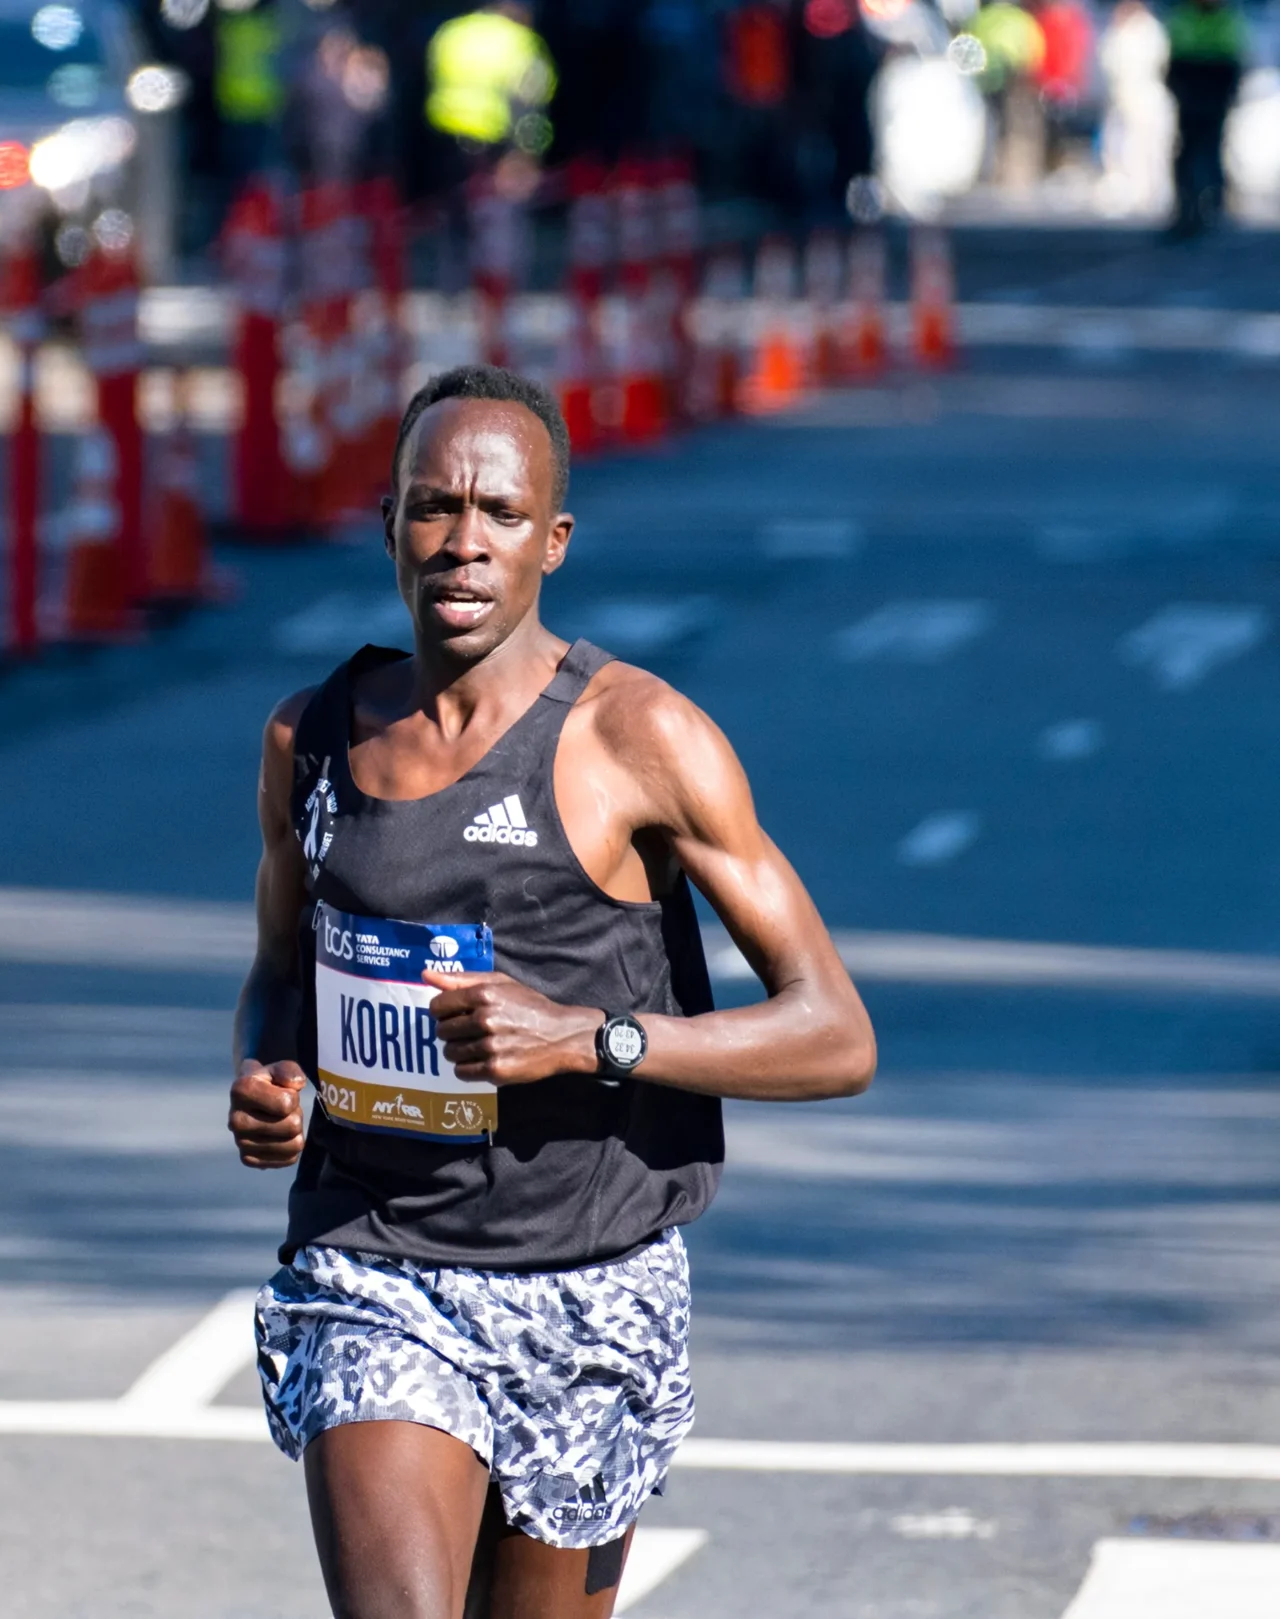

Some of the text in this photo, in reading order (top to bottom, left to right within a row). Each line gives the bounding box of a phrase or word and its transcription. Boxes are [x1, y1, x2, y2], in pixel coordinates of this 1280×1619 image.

[463, 824, 538, 847] adidas
[324, 915, 354, 960] tcs
[355, 933, 380, 946] TATA
[355, 945, 411, 959] CONSULTANCY
[356, 954, 391, 967] SERVICES
[340, 993, 440, 1077] KORIR
[320, 1080, 356, 1113] 2021
[552, 1503, 613, 1521] adidas
